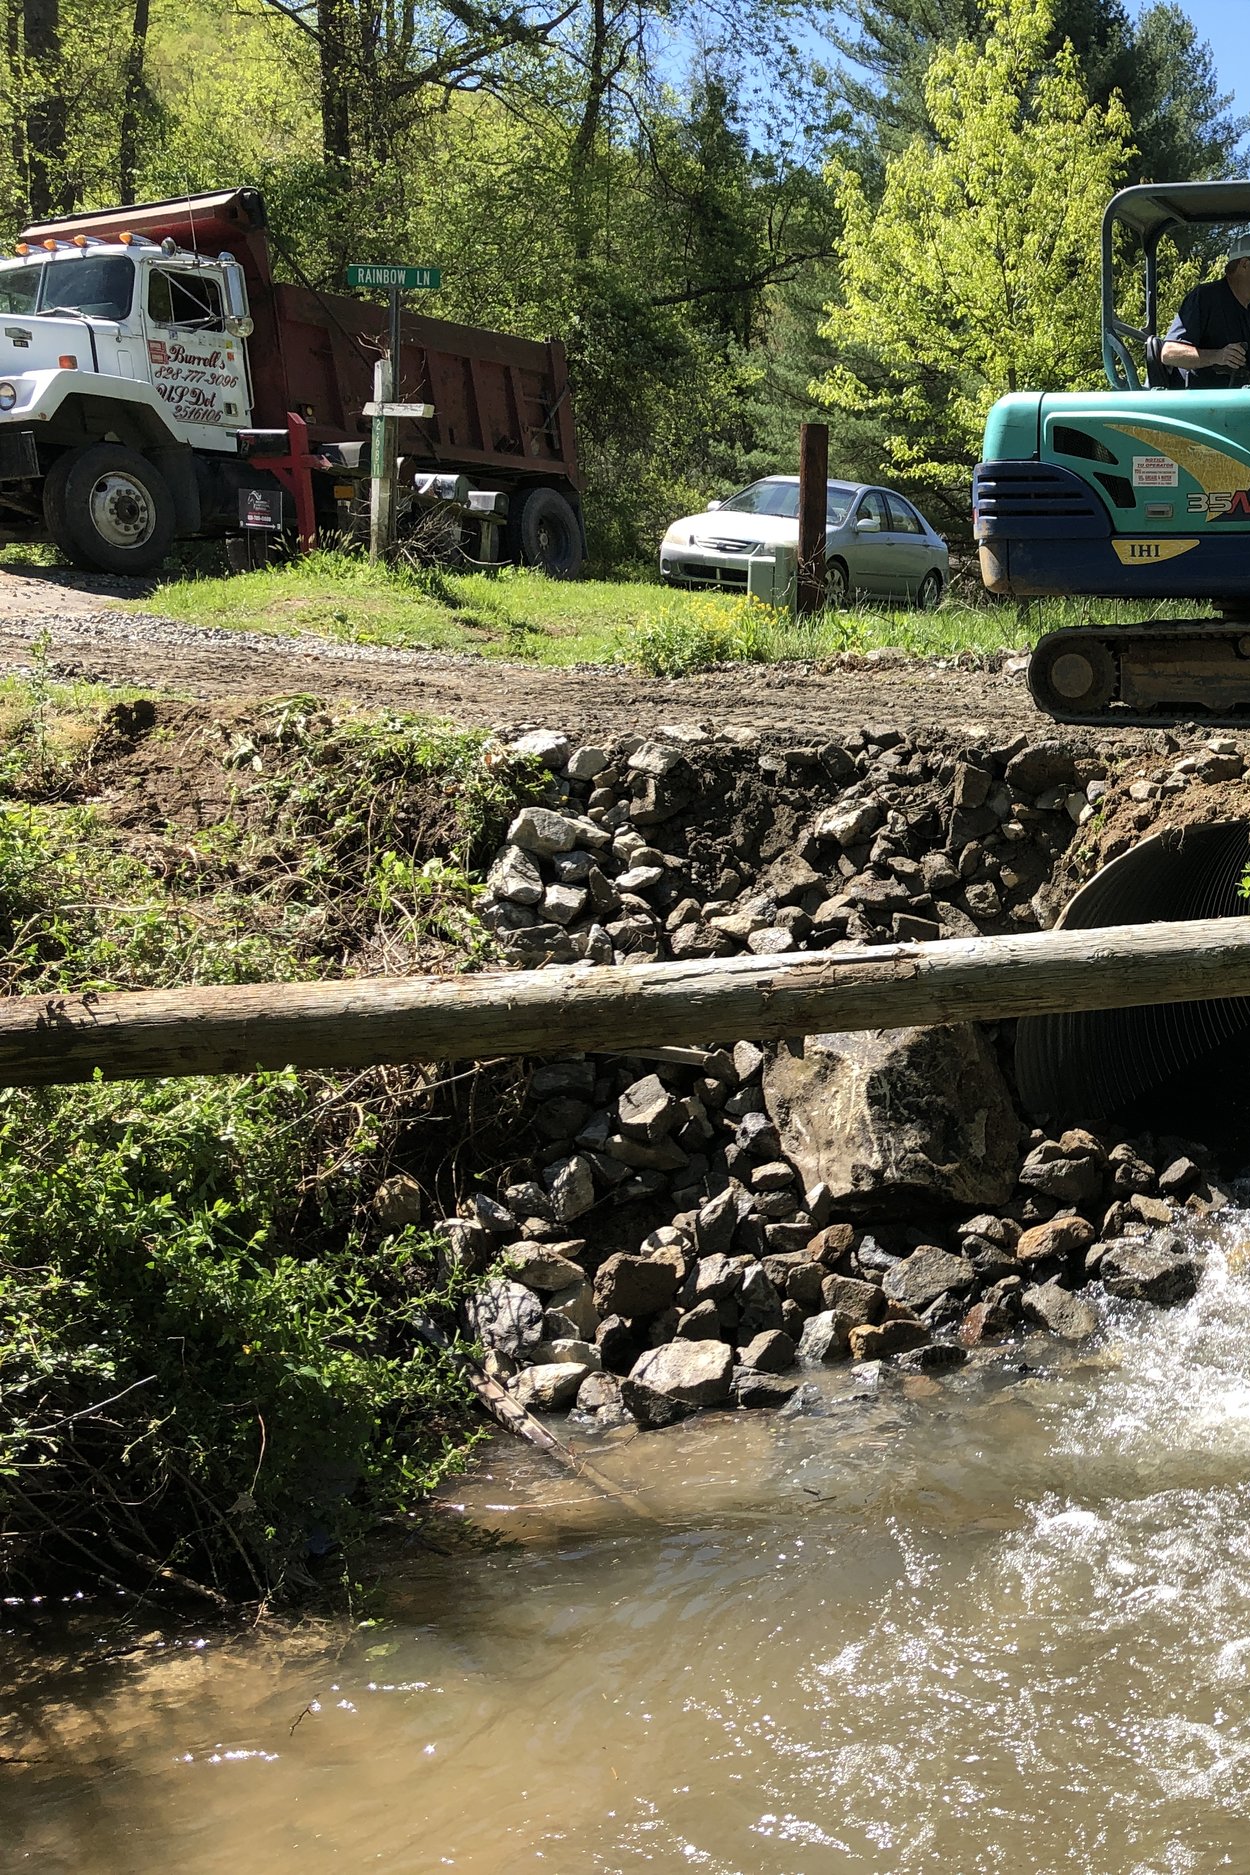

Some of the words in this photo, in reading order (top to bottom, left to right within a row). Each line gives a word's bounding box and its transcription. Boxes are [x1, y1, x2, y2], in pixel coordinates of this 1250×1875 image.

[357, 268, 406, 285] RAINBOW
[416, 270, 430, 286] LN
[169, 344, 226, 370] Burrell's
[154, 366, 239, 388] 828-777-3096
[185, 387, 217, 408] Dot
[1130, 544, 1161, 558] IHI
